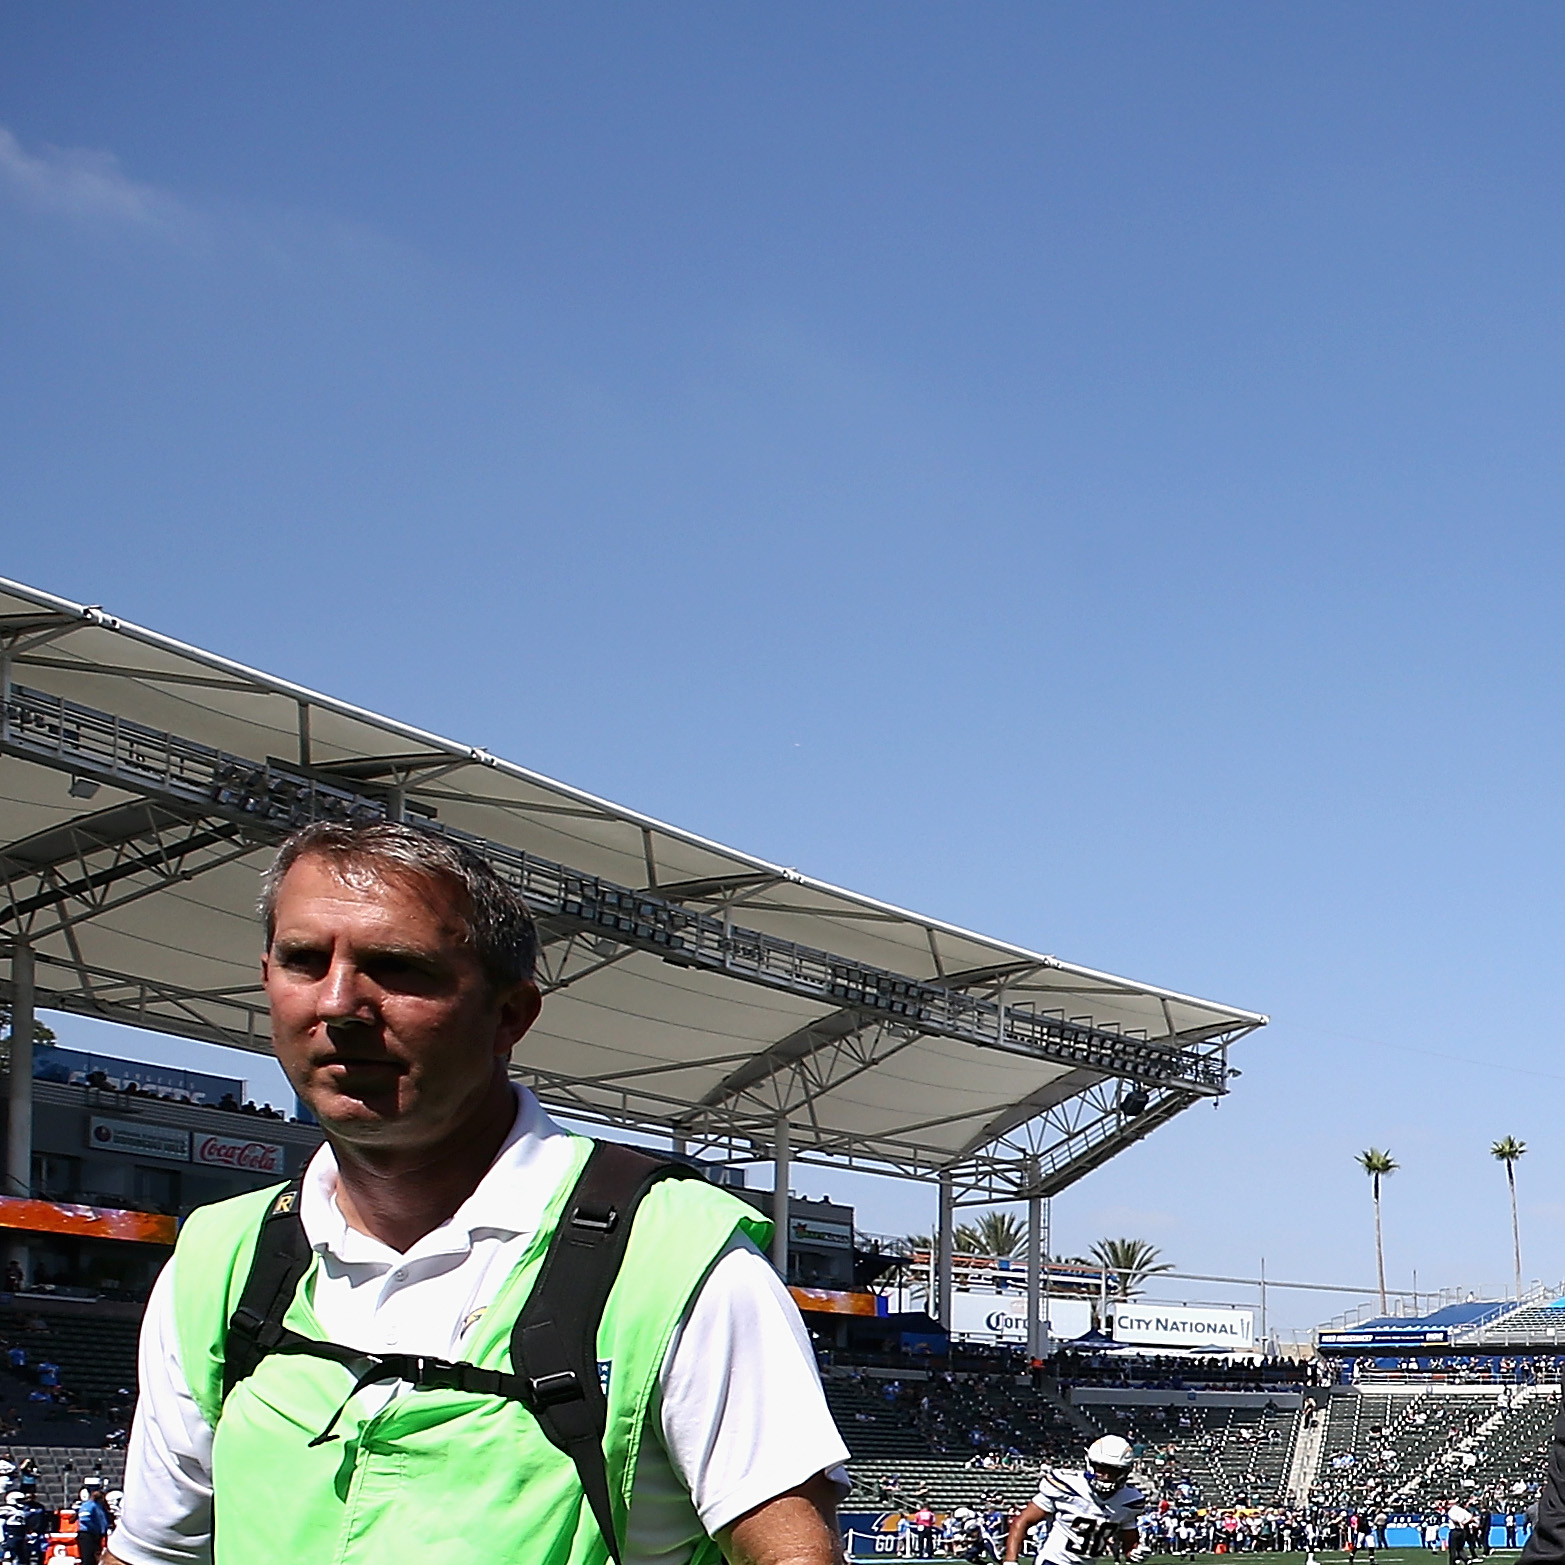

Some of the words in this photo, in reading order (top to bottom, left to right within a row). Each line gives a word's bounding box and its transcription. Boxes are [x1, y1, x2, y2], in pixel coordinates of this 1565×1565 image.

[200, 1137, 277, 1170] Coca-Cola
[1117, 1316, 1153, 1331] CITY
[1155, 1318, 1239, 1336] NATIONAL
[875, 1538, 895, 1554] GO
